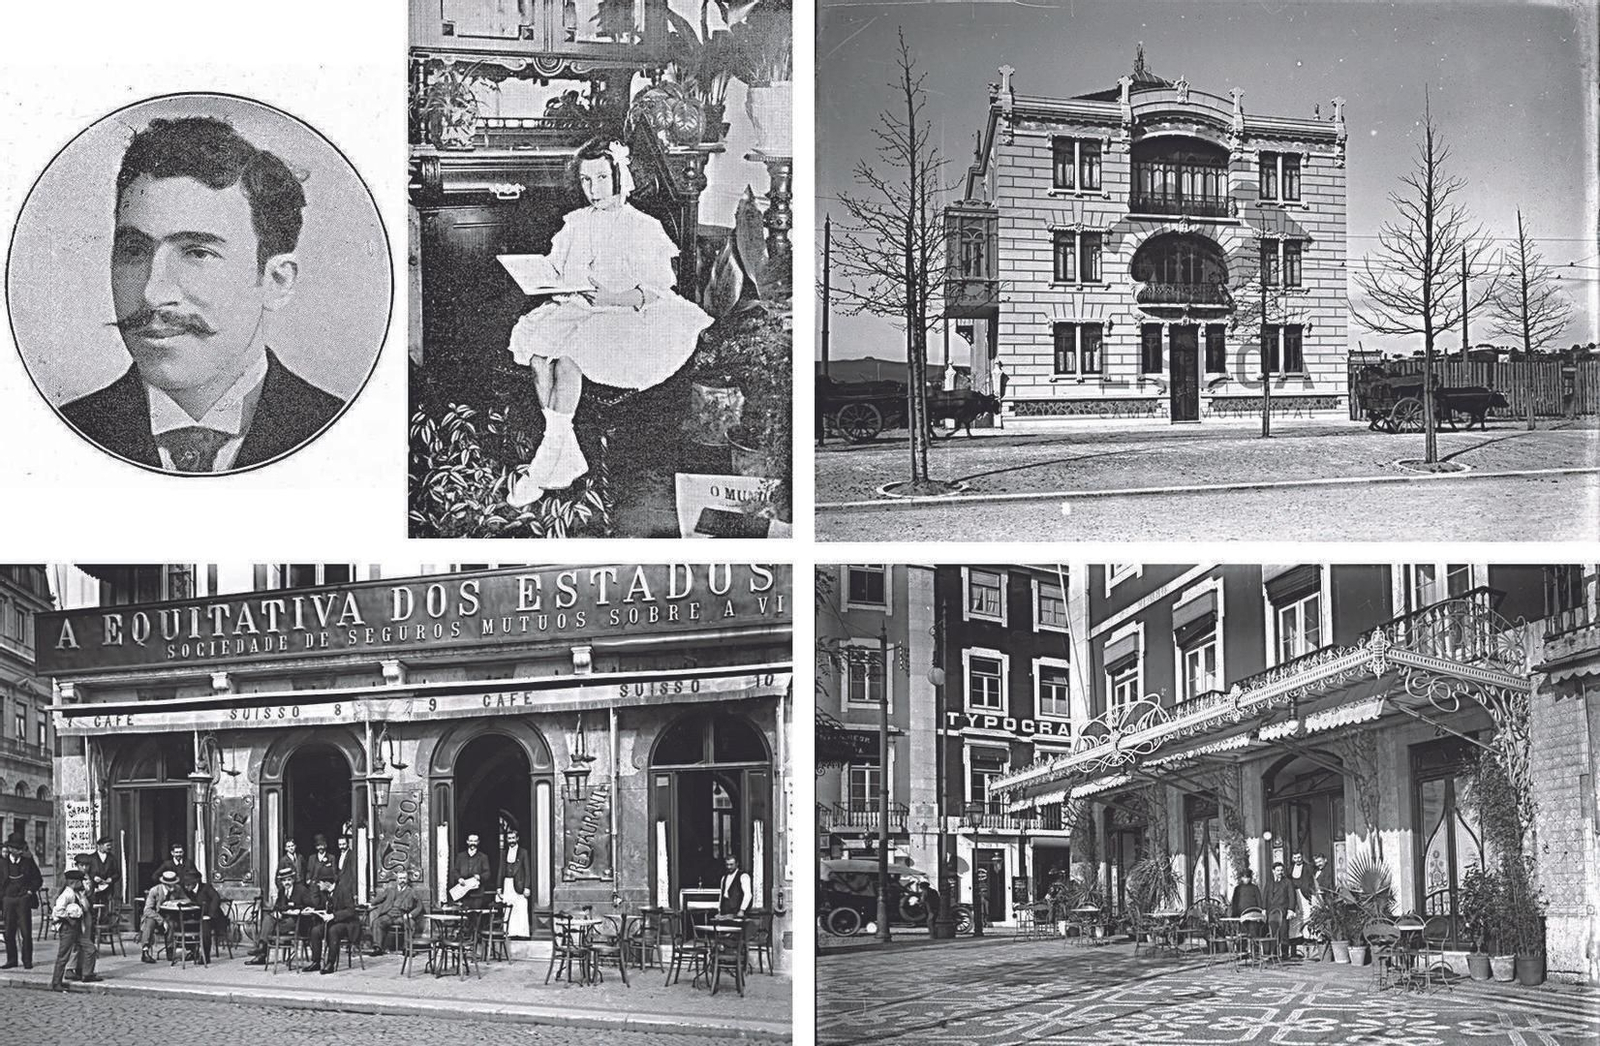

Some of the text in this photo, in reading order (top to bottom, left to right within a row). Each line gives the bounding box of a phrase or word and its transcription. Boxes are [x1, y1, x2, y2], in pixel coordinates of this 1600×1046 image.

[710, 486, 719, 496] O
[55, 564, 775, 649] A EQUITATIVA DOS ESTADOS
[167, 595, 784, 659] SOCIEDADE DE SEGUROS MUTUOS SOBRE A VI
[94, 714, 134, 728] CAFE
[229, 706, 300, 720] SUISSO
[334, 704, 342, 716] 8
[428, 698, 437, 712] 9
[483, 692, 533, 708] CAFE
[619, 679, 700, 698] SUISSO
[755, 674, 774, 688] 10
